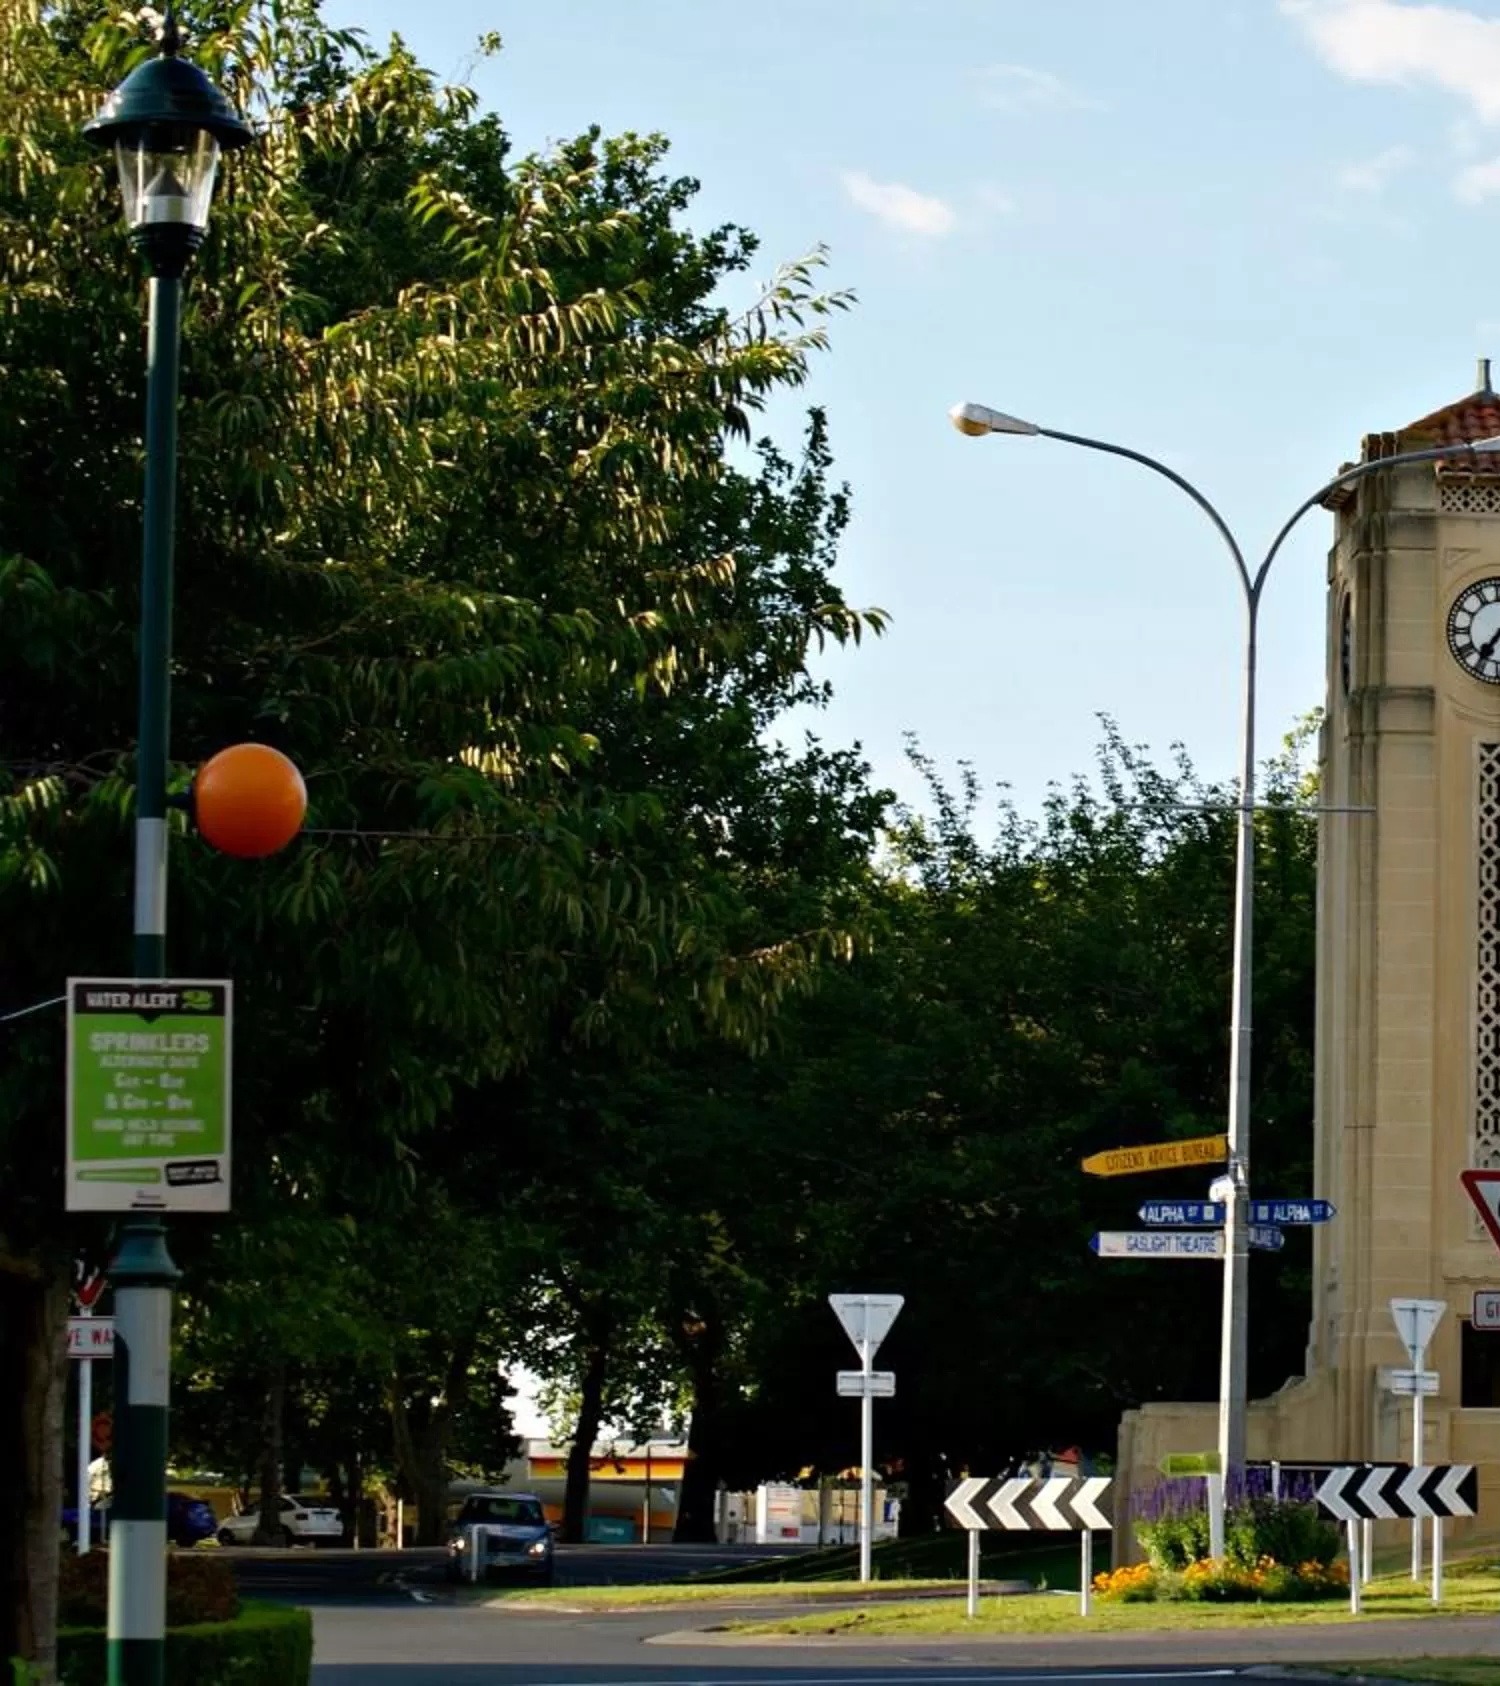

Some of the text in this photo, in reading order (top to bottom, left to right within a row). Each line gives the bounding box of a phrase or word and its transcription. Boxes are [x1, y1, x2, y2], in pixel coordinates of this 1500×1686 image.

[86, 993, 177, 1009] WATER ALERT
[1148, 1147, 1177, 1165] ADVICE
[1182, 1142, 1215, 1161] BUREAU
[1147, 1206, 1185, 1223] ALPHA
[1273, 1204, 1311, 1221] ALPHA
[1127, 1235, 1217, 1253] GASLIGHT THEATRE
[92, 1328, 112, 1345] WA
